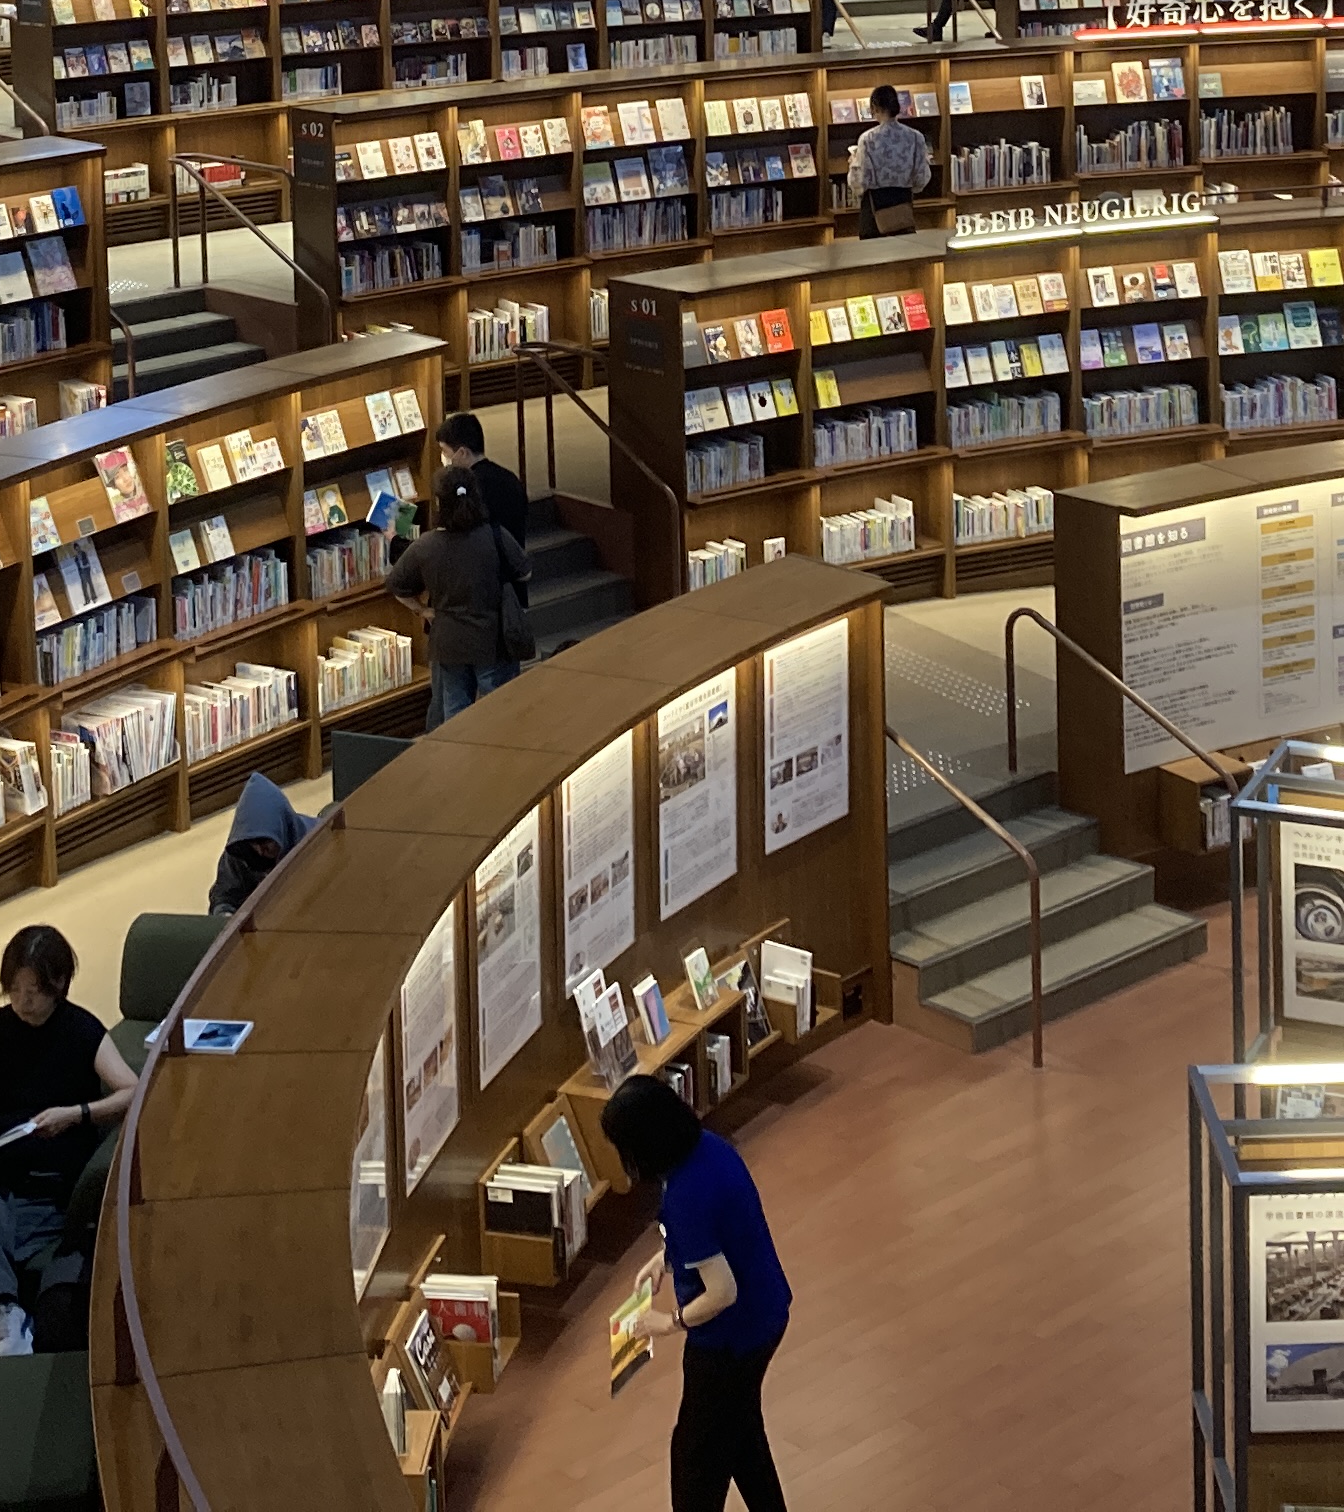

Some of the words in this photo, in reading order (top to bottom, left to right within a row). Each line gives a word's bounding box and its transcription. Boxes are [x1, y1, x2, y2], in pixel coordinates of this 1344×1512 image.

[309, 122, 324, 138] 02
[955, 207, 1035, 237] BLEIB
[1044, 190, 1201, 228] NEUGIERIG
[641, 298, 657, 317] 01
